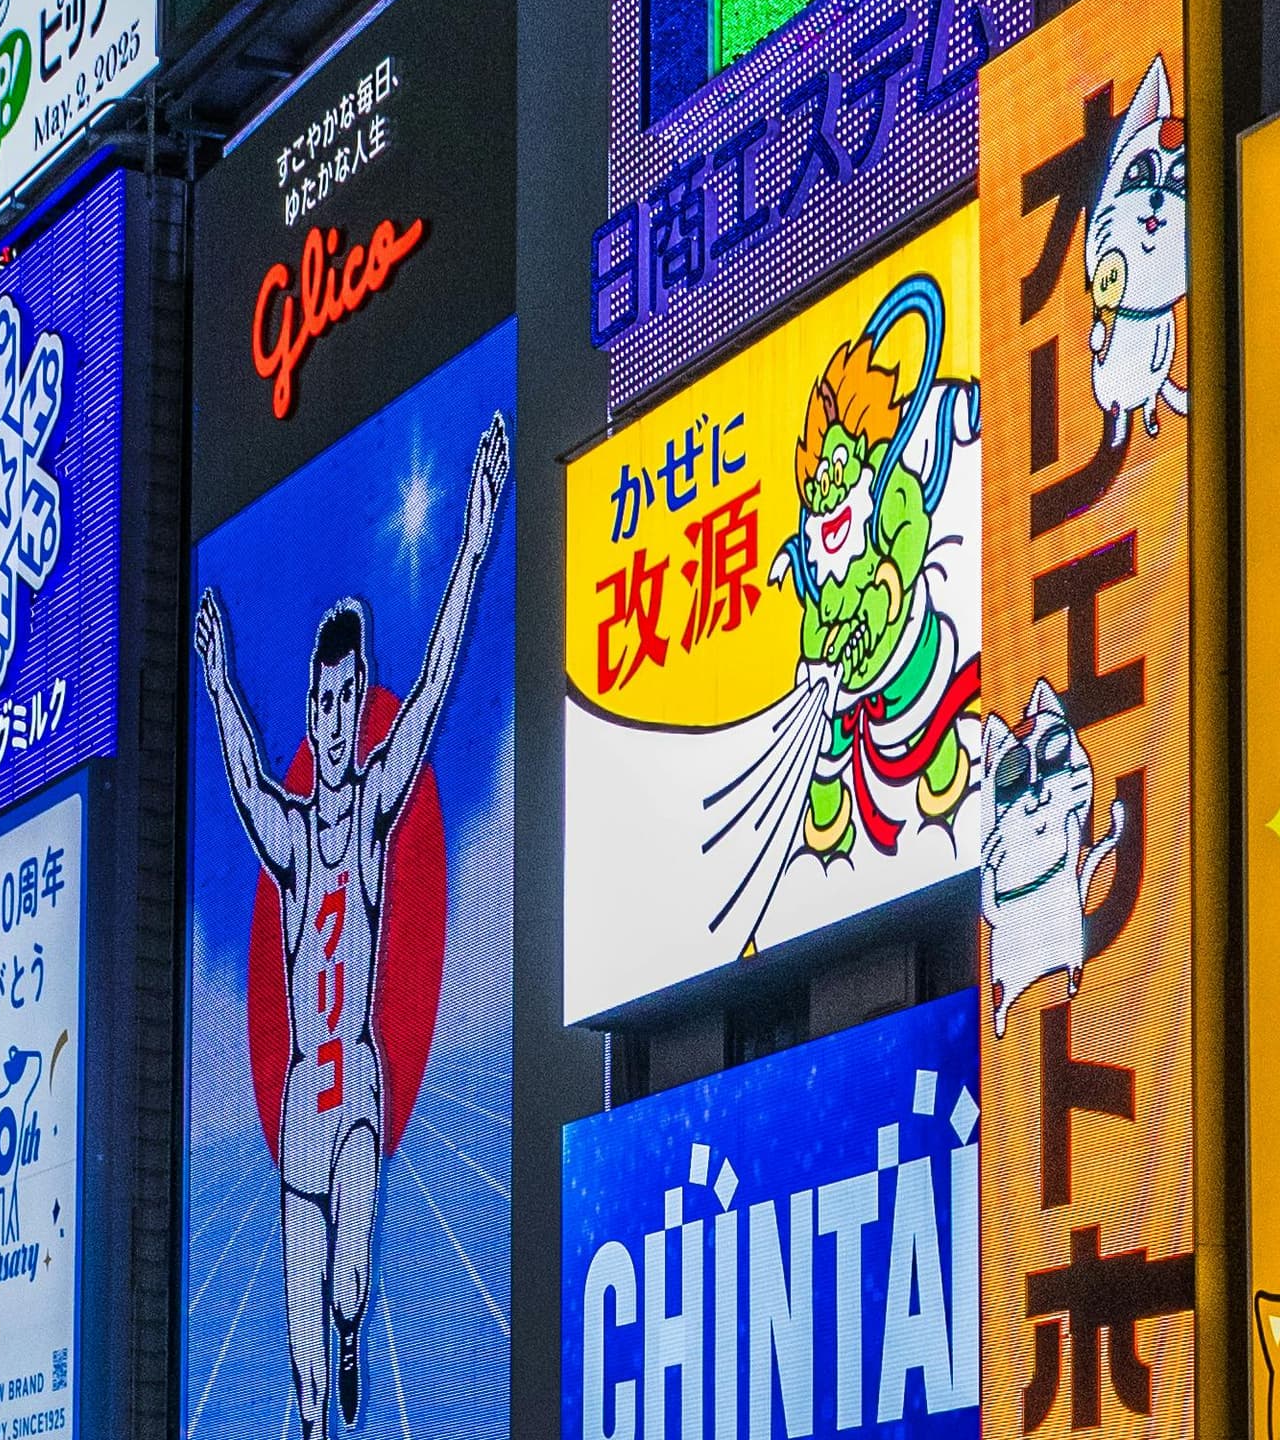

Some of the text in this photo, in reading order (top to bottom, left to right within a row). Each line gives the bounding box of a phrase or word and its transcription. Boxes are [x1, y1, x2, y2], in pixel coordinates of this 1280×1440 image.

[94, 18, 141, 93] 2025
[276, 56, 399, 187] すこやかな毎日、
[284, 117, 386, 227] ゆたかな人生
[251, 217, 423, 420] Glico
[609, 410, 748, 545] かぜに
[594, 480, 763, 696] 改源
[315, 871, 351, 1114] グリコ
[8, 1372, 45, 1402] BRAND
